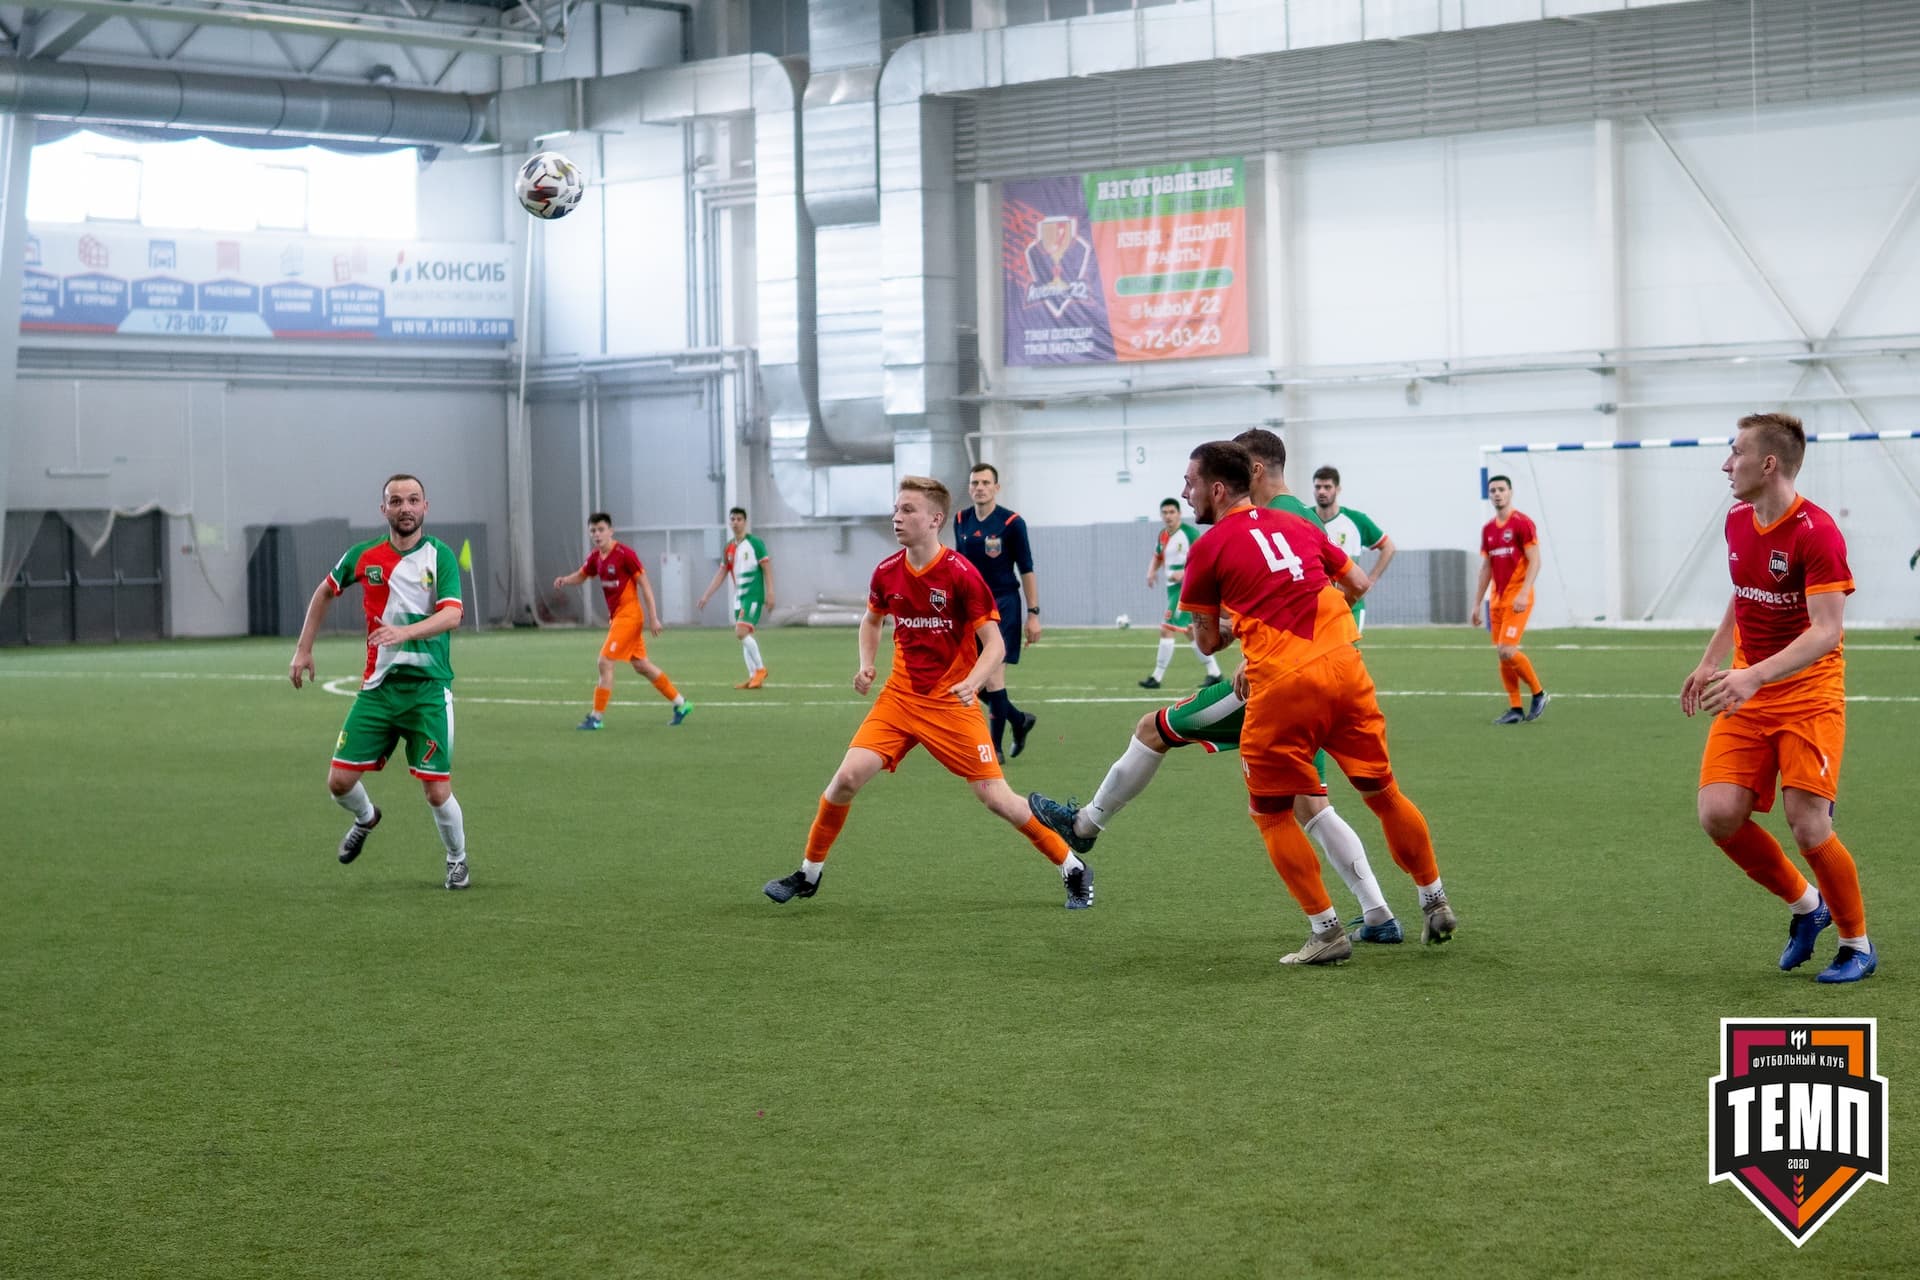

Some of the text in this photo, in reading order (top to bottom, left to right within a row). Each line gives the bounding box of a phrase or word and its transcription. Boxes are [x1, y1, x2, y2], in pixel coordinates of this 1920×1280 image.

[1098, 167, 1234, 200] ИЗГОТОВЛЕНИЕ
[417, 260, 506, 283] КОНСИБ
[165, 315, 229, 332] 73-00-37
[391, 318, 509, 335] www.konsib.com
[1144, 326, 1221, 349] 72-03-23
[1249, 528, 1305, 582] 4
[1734, 585, 1800, 605] ОДИНВЕСТ
[422, 739, 438, 763] 7
